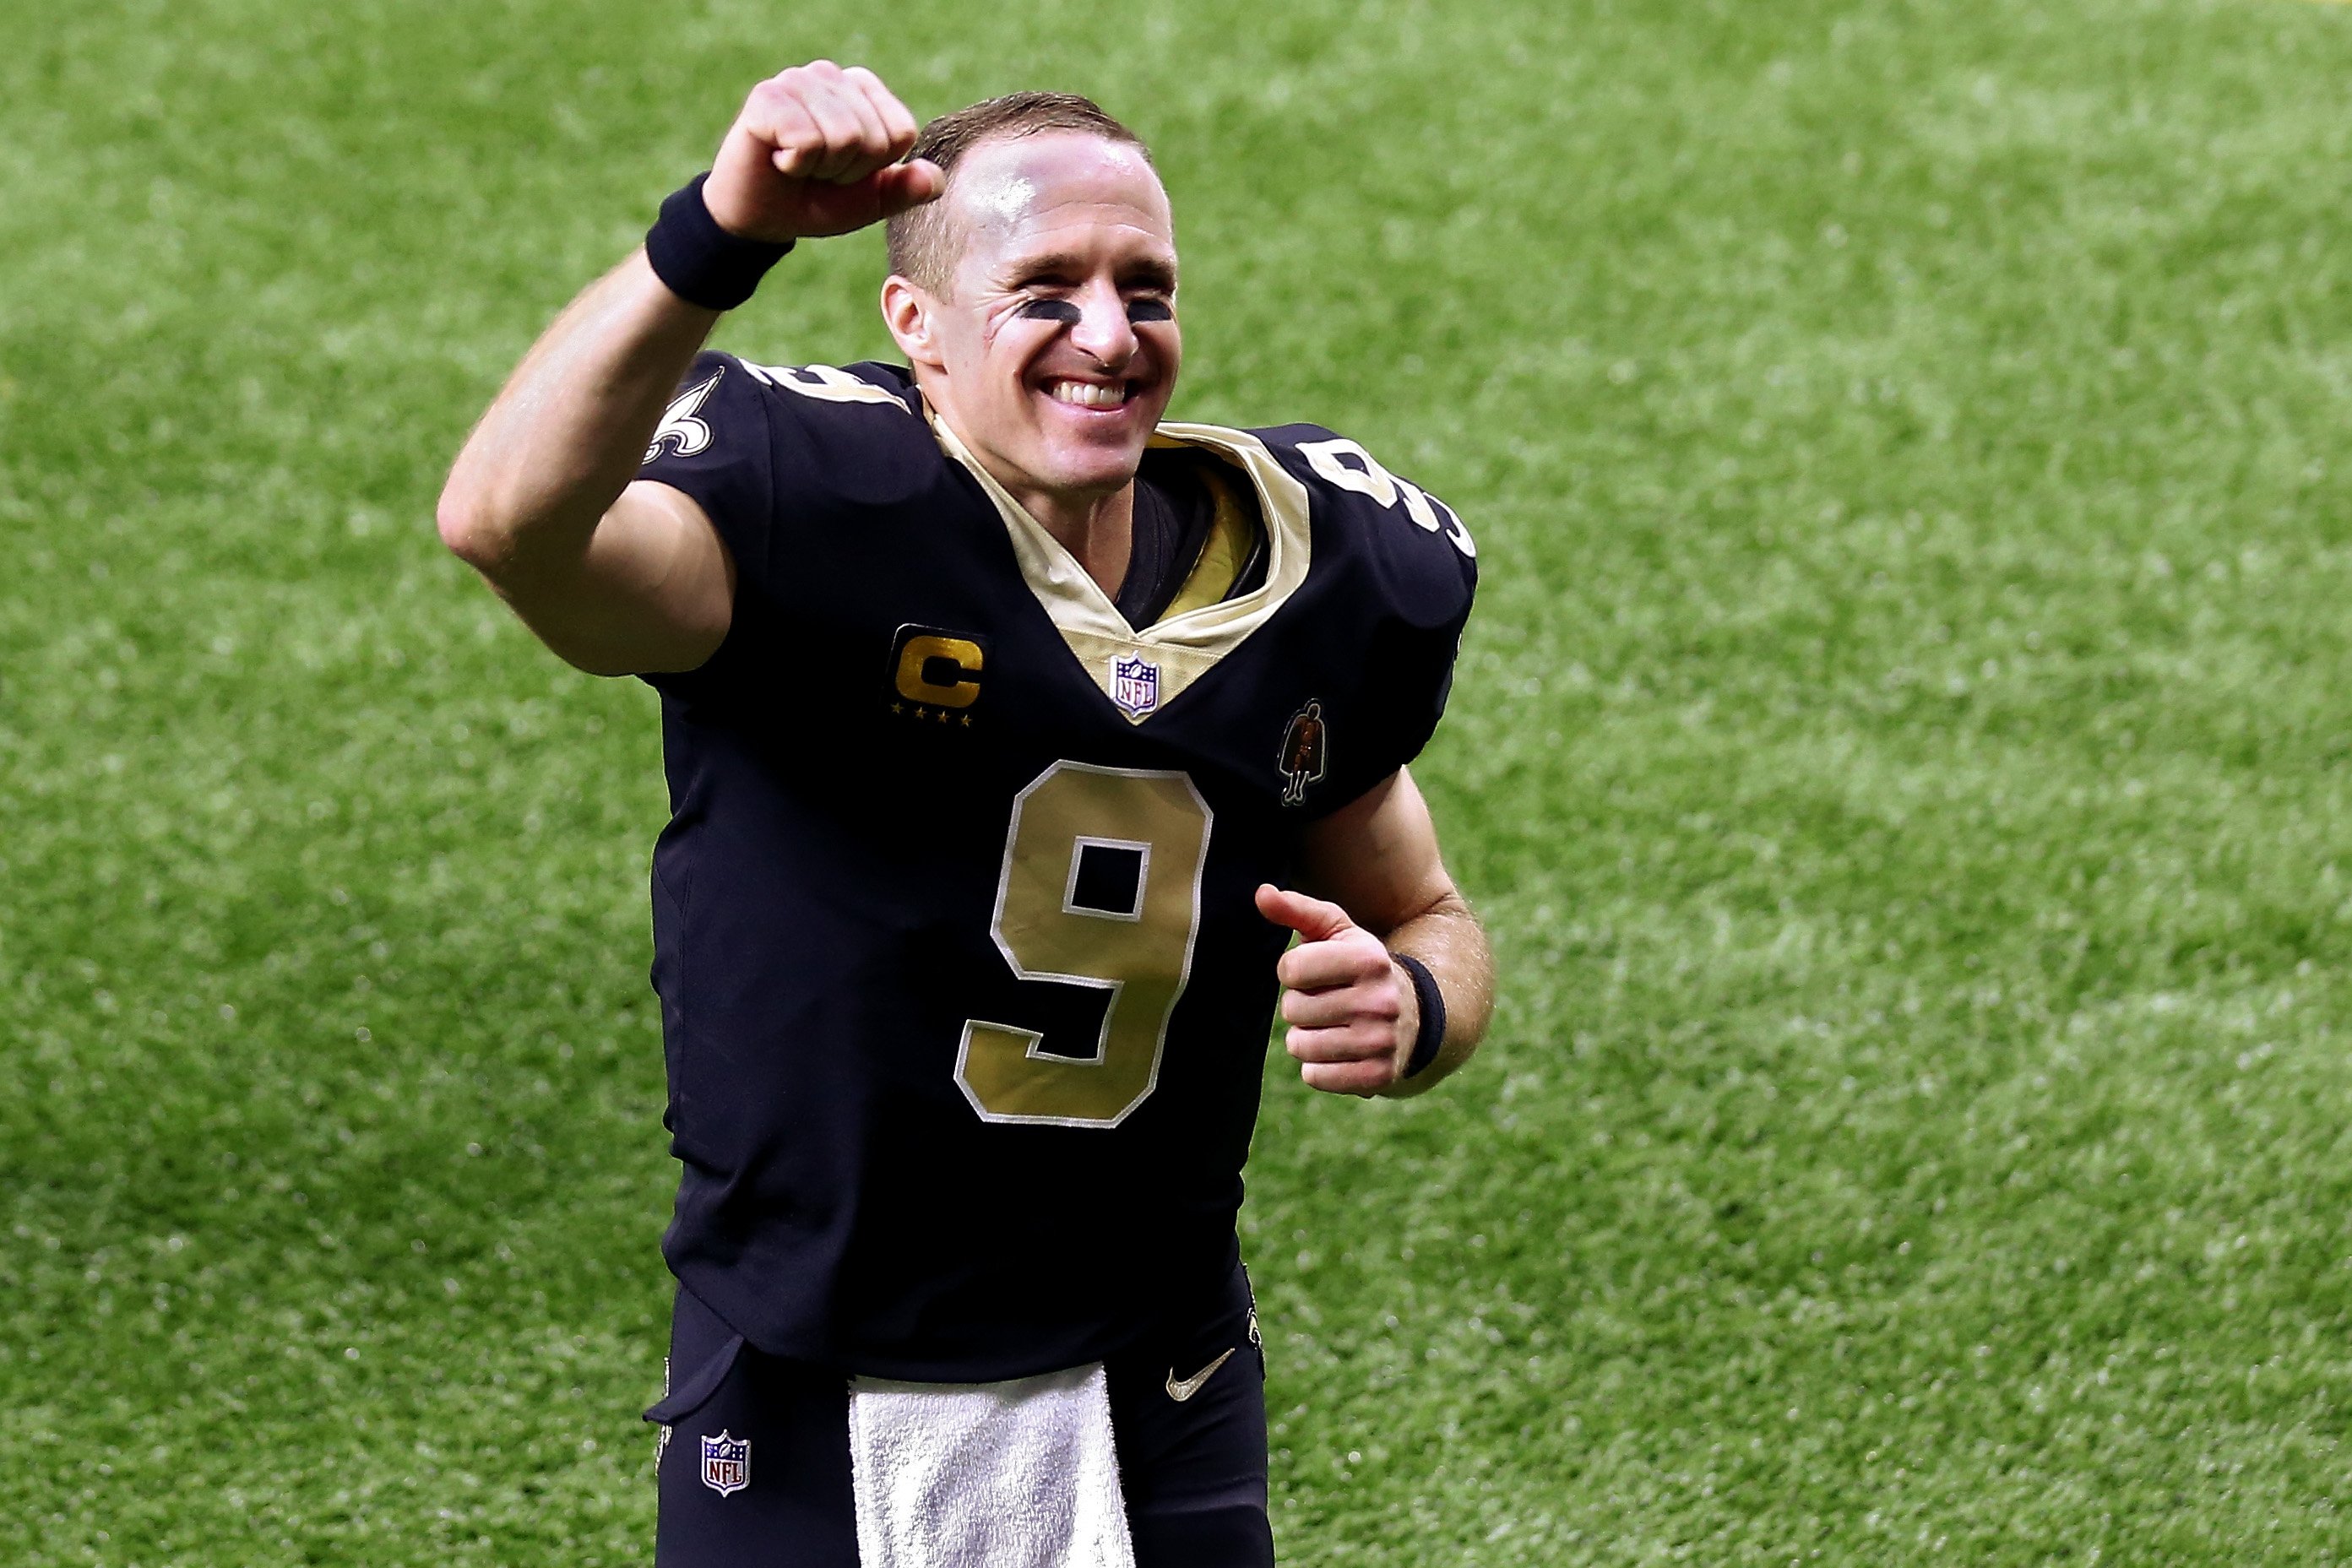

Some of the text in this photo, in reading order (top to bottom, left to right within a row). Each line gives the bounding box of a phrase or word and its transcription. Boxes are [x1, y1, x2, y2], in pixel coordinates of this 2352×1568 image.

[1295, 438, 1476, 558] 9
[896, 635, 983, 708] C
[1121, 679, 1154, 706] NFL
[953, 759, 1214, 1129] 9
[709, 1461, 742, 1485] NFL
